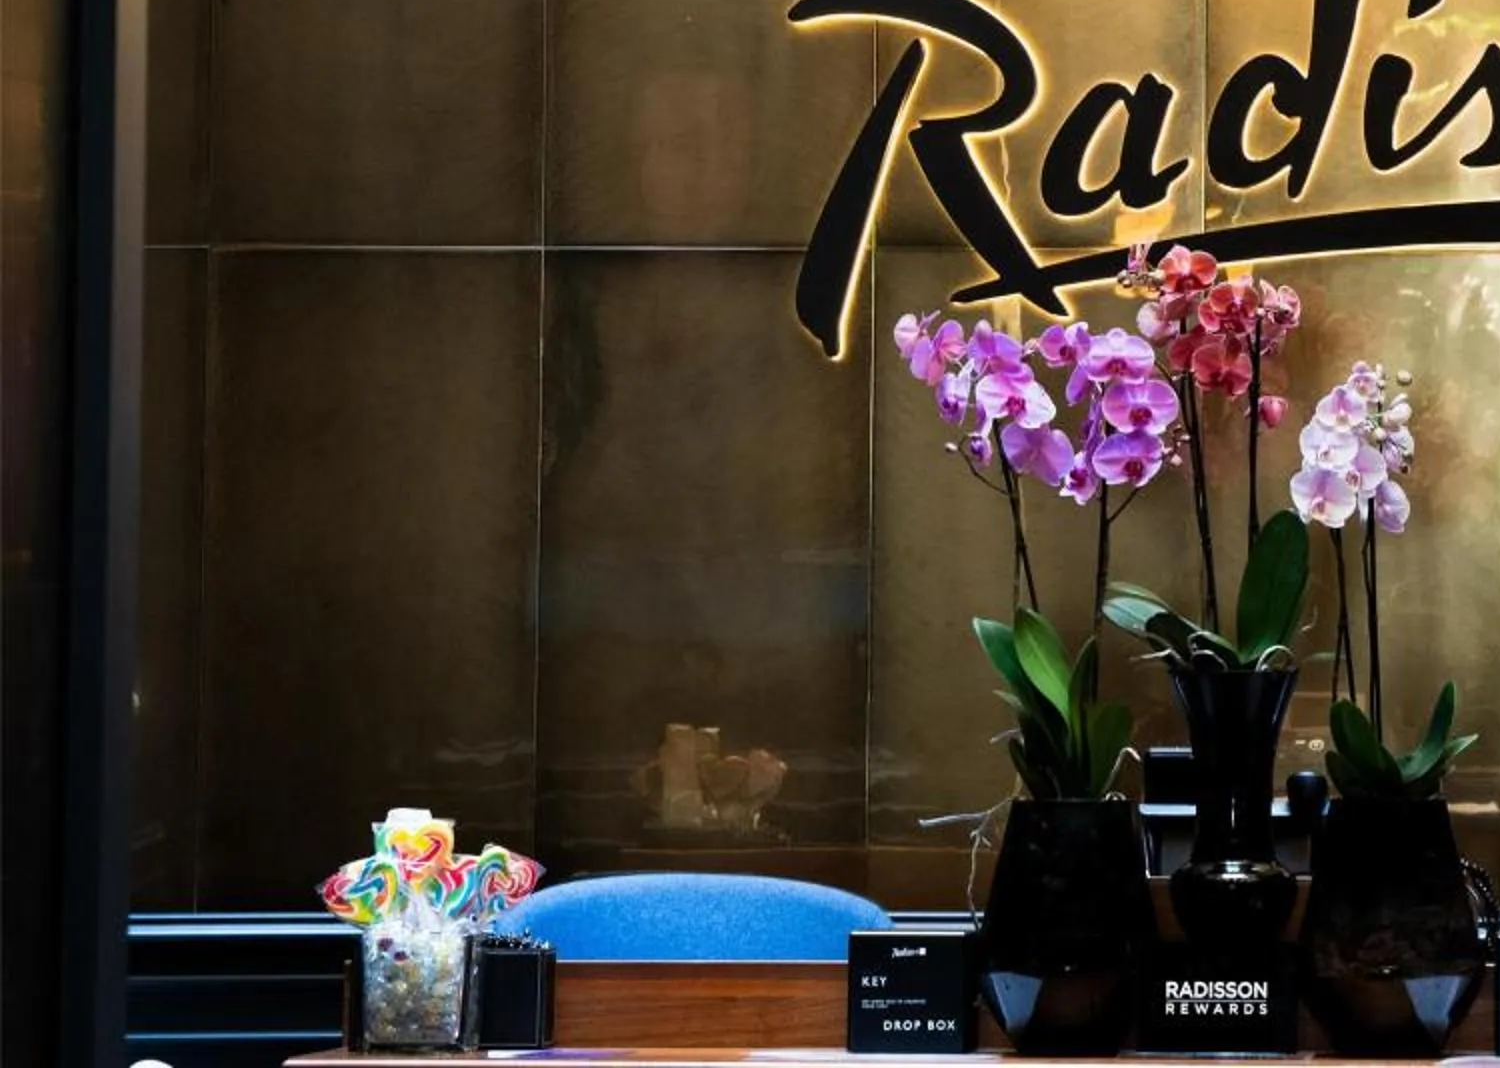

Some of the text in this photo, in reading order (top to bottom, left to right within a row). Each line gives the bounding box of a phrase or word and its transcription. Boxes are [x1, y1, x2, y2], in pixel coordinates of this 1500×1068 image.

[861, 975, 887, 988] KEY
[1165, 981, 1268, 999] RADISSON
[1165, 1003, 1268, 1016] REWARDS
[883, 1019, 956, 1032] DROP BOX
